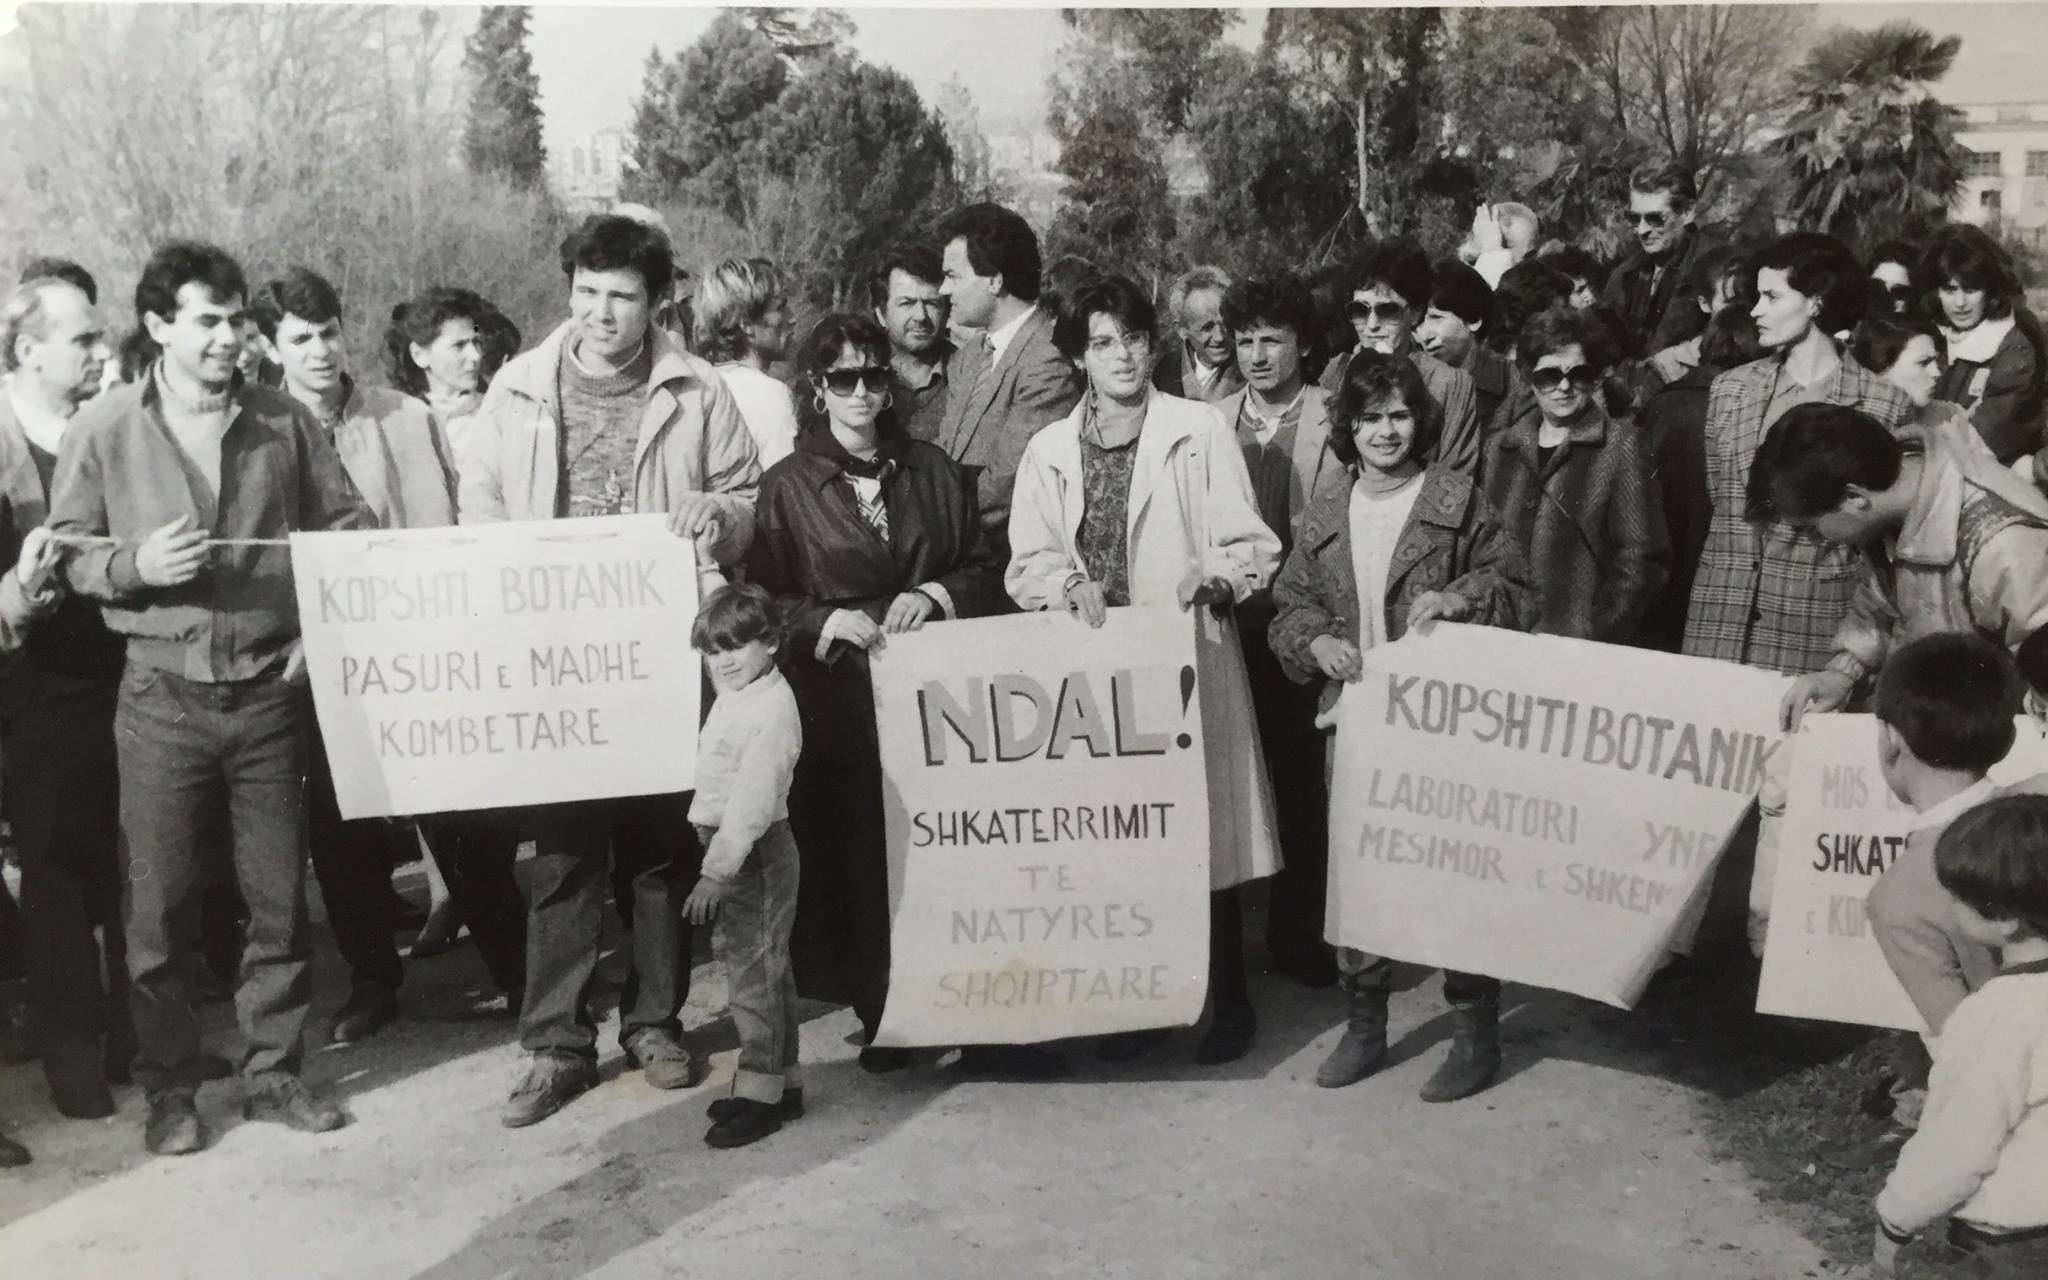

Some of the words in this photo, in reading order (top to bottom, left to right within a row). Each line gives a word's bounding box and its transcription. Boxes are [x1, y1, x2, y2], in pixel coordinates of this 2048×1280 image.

[318, 570, 470, 624] KOPSHTI
[501, 559, 665, 615] BOTANIK
[342, 650, 480, 696] PASURI
[530, 641, 649, 688] MADHE
[380, 708, 609, 758] KOMBETARE
[917, 665, 1195, 767] NDAL!
[1385, 673, 1579, 758] KOPSHTI
[1582, 705, 1782, 796] BOTANIK
[1367, 768, 1578, 844] LABORATORI
[1821, 765, 1869, 809] MOS
[913, 804, 1175, 847] SHKATERRIMIT
[1018, 864, 1076, 893] TE
[1358, 824, 1506, 884] MESIMOR
[1563, 863, 1673, 915] SHKEN
[1812, 833, 1909, 876] SHKAT
[951, 902, 1155, 945] NATYRES
[934, 965, 1170, 1009] SHQIPTARE
